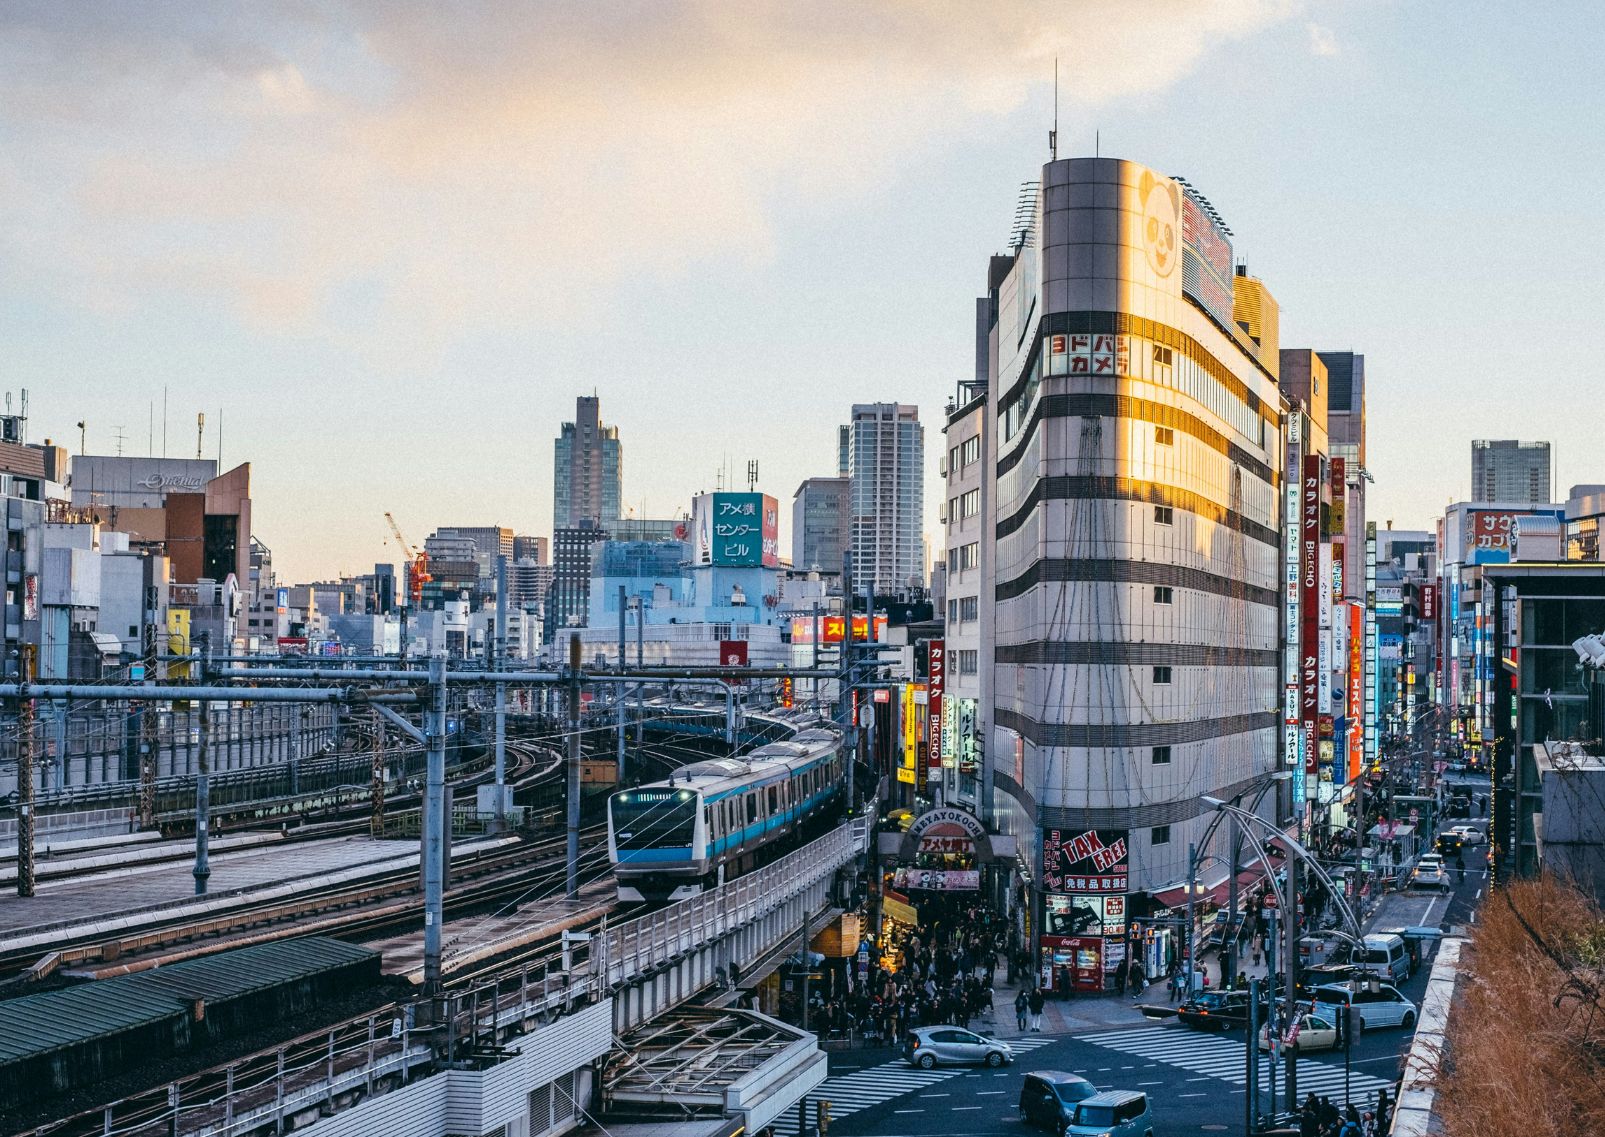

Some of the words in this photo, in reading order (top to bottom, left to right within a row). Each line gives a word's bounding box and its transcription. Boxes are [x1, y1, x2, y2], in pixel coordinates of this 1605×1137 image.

[1053, 335, 1128, 353] ヨドバシ
[1072, 356, 1128, 373] カメラ
[719, 502, 755, 516] アメ横
[1306, 477, 1317, 529] カラオケ
[715, 523, 759, 536] センター
[724, 543, 749, 556] ビル
[1305, 541, 1315, 560] BIG
[1305, 560, 1315, 588] ECHO
[931, 648, 942, 698] カラオケ
[1304, 656, 1316, 708] カラオケ
[931, 715, 940, 732] BIG
[1304, 720, 1314, 738] BIG
[931, 732, 940, 759] ECHO
[962, 714, 972, 761] ルノアール
[1287, 731, 1295, 759] ルノアール
[1306, 739, 1314, 767] ECHO
[911, 812, 984, 842] AMEYAYOKOCHO
[1062, 830, 1105, 865] TAX
[1091, 837, 1128, 873] FREE
[1067, 878, 1126, 889] 免税品取扱店
